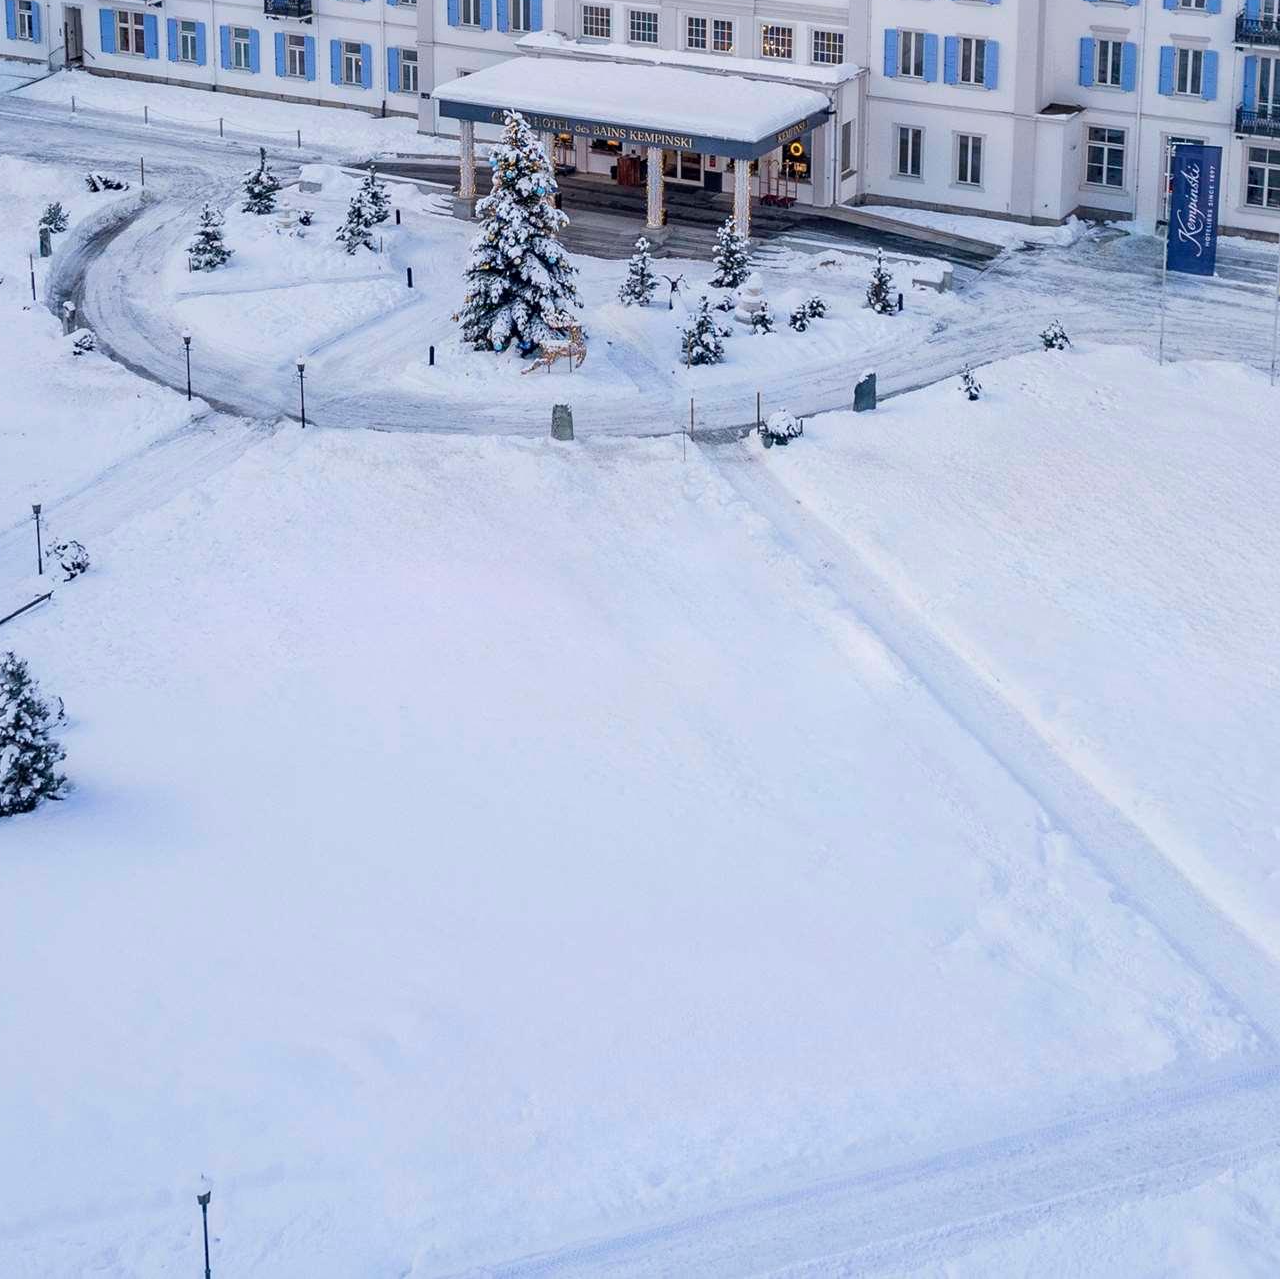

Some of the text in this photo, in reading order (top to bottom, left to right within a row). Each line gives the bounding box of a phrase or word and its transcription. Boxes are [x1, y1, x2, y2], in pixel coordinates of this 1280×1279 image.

[593, 125, 626, 139] BAINS
[630, 129, 692, 148] KEMPINSKI
[1177, 163, 1206, 257] Kempinski
